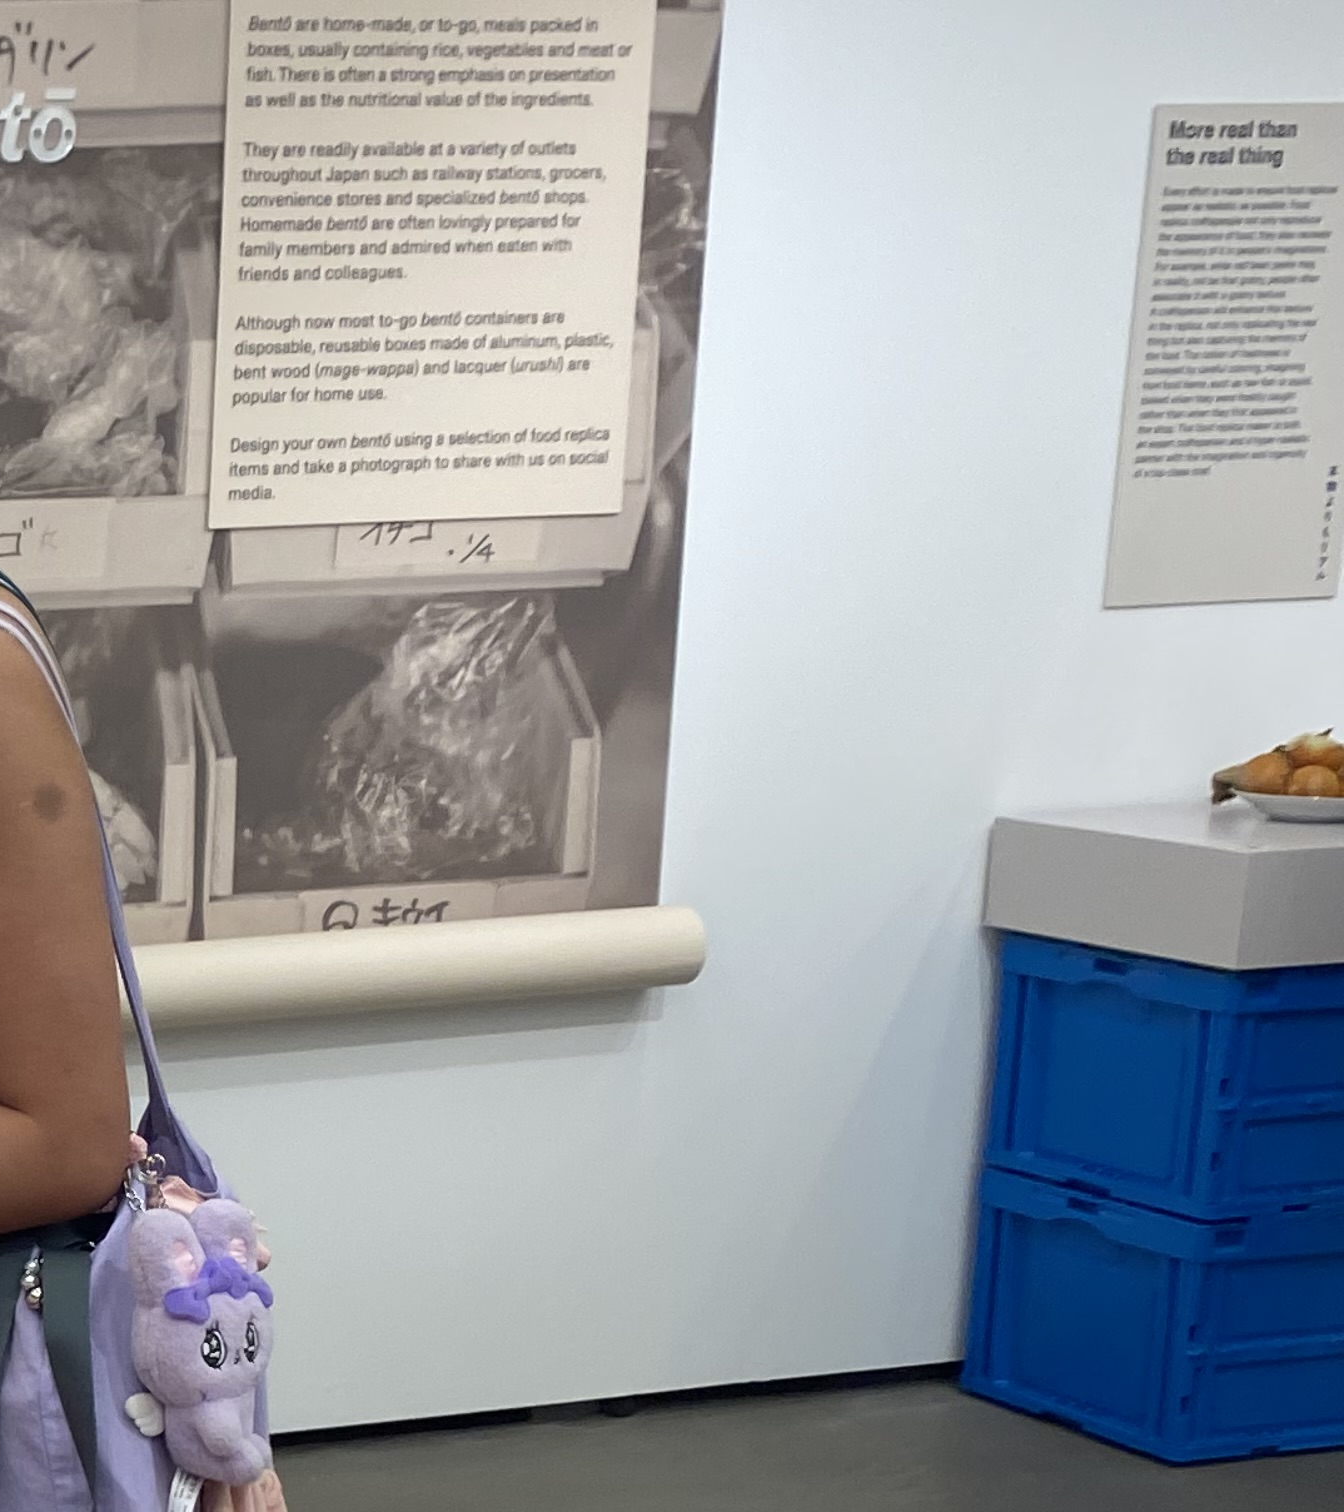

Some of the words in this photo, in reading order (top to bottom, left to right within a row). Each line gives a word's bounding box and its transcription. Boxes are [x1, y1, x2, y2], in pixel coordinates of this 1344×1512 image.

[1168, 120, 1215, 138] More
[1218, 120, 1254, 138] real
[1257, 120, 1297, 137] than
[243, 142, 279, 160] They
[281, 145, 306, 156] are
[309, 142, 359, 159] readily
[360, 141, 425, 156] available
[428, 141, 443, 155] at
[446, 144, 455, 155] a
[459, 141, 507, 158] variety
[510, 141, 525, 155] of
[528, 140, 576, 155] outlets
[1166, 147, 1195, 164] the
[1198, 147, 1234, 164] real
[1238, 147, 1284, 168] thing
[242, 167, 322, 184] throughout
[325, 167, 369, 184] Japan
[373, 166, 408, 181] such
[411, 169, 428, 180] as
[432, 166, 482, 184] railway
[241, 191, 332, 206] convenience
[336, 191, 381, 205] stores
[383, 191, 412, 205] and
[416, 190, 495, 208] specialized
[240, 216, 322, 230] Homemade
[370, 218, 394, 229] are
[397, 214, 434, 229] often
[438, 214, 492, 232] lovingly
[494, 213, 558, 231] prepared
[561, 213, 580, 227] for
[238, 241, 282, 259] family
[285, 240, 355, 255] members
[359, 239, 387, 254] and
[390, 239, 450, 253] admired
[454, 238, 493, 253] when
[496, 238, 537, 252] eaten
[542, 237, 571, 252] with
[237, 266, 288, 280] friends
[293, 266, 320, 280] and
[235, 314, 300, 333] Although
[304, 317, 335, 328] now
[338, 313, 374, 328] most
[378, 312, 417, 331] to-go
[464, 310, 537, 326] containers
[542, 313, 564, 324] are
[318, 338, 380, 352] reusable
[384, 337, 425, 351] boxes
[429, 336, 468, 351] made
[472, 336, 486, 350] of
[233, 363, 266, 378] bent
[270, 362, 310, 377] wood
[314, 360, 418, 380] (mage-wappa)
[422, 360, 449, 374] and
[453, 359, 507, 377] lacquer
[510, 357, 563, 376] (urushi)
[566, 360, 590, 371] are
[232, 387, 287, 406] popular
[290, 387, 310, 401] for
[313, 386, 353, 401] home
[230, 436, 279, 455] Design
[280, 438, 314, 454] your
[316, 437, 346, 449] own
[394, 431, 432, 450] using
[435, 434, 444, 445] a
[448, 429, 510, 445] selection
[513, 429, 527, 443] of
[530, 428, 561, 442] food
[564, 426, 609, 445] replica
[229, 461, 268, 476] items
[272, 460, 299, 475] and
[302, 459, 334, 474] take
[337, 461, 346, 473] a
[350, 456, 431, 476] photograph
[434, 455, 449, 470] to
[452, 454, 491, 469] share
[495, 453, 524, 468] with
[528, 455, 544, 467] us
[547, 454, 565, 466] on
[569, 450, 609, 465] social
